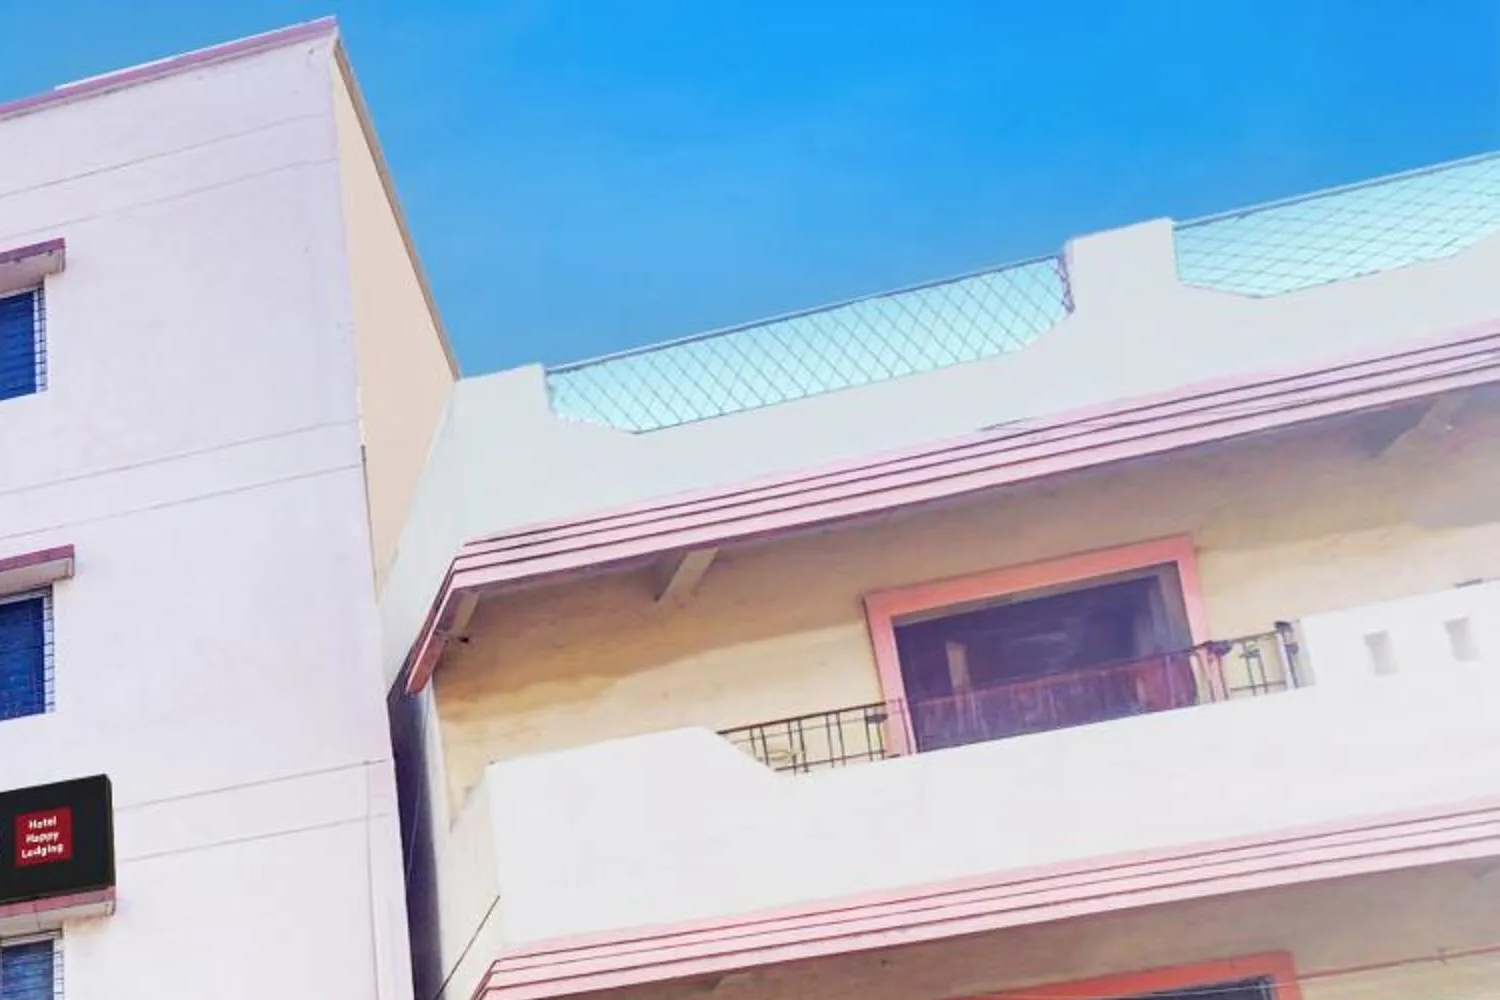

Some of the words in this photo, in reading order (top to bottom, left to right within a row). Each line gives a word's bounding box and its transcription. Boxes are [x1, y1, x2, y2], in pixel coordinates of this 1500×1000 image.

[28, 815, 57, 830] Hotel
[25, 831, 59, 844] Happy
[21, 843, 64, 859] Lodging
